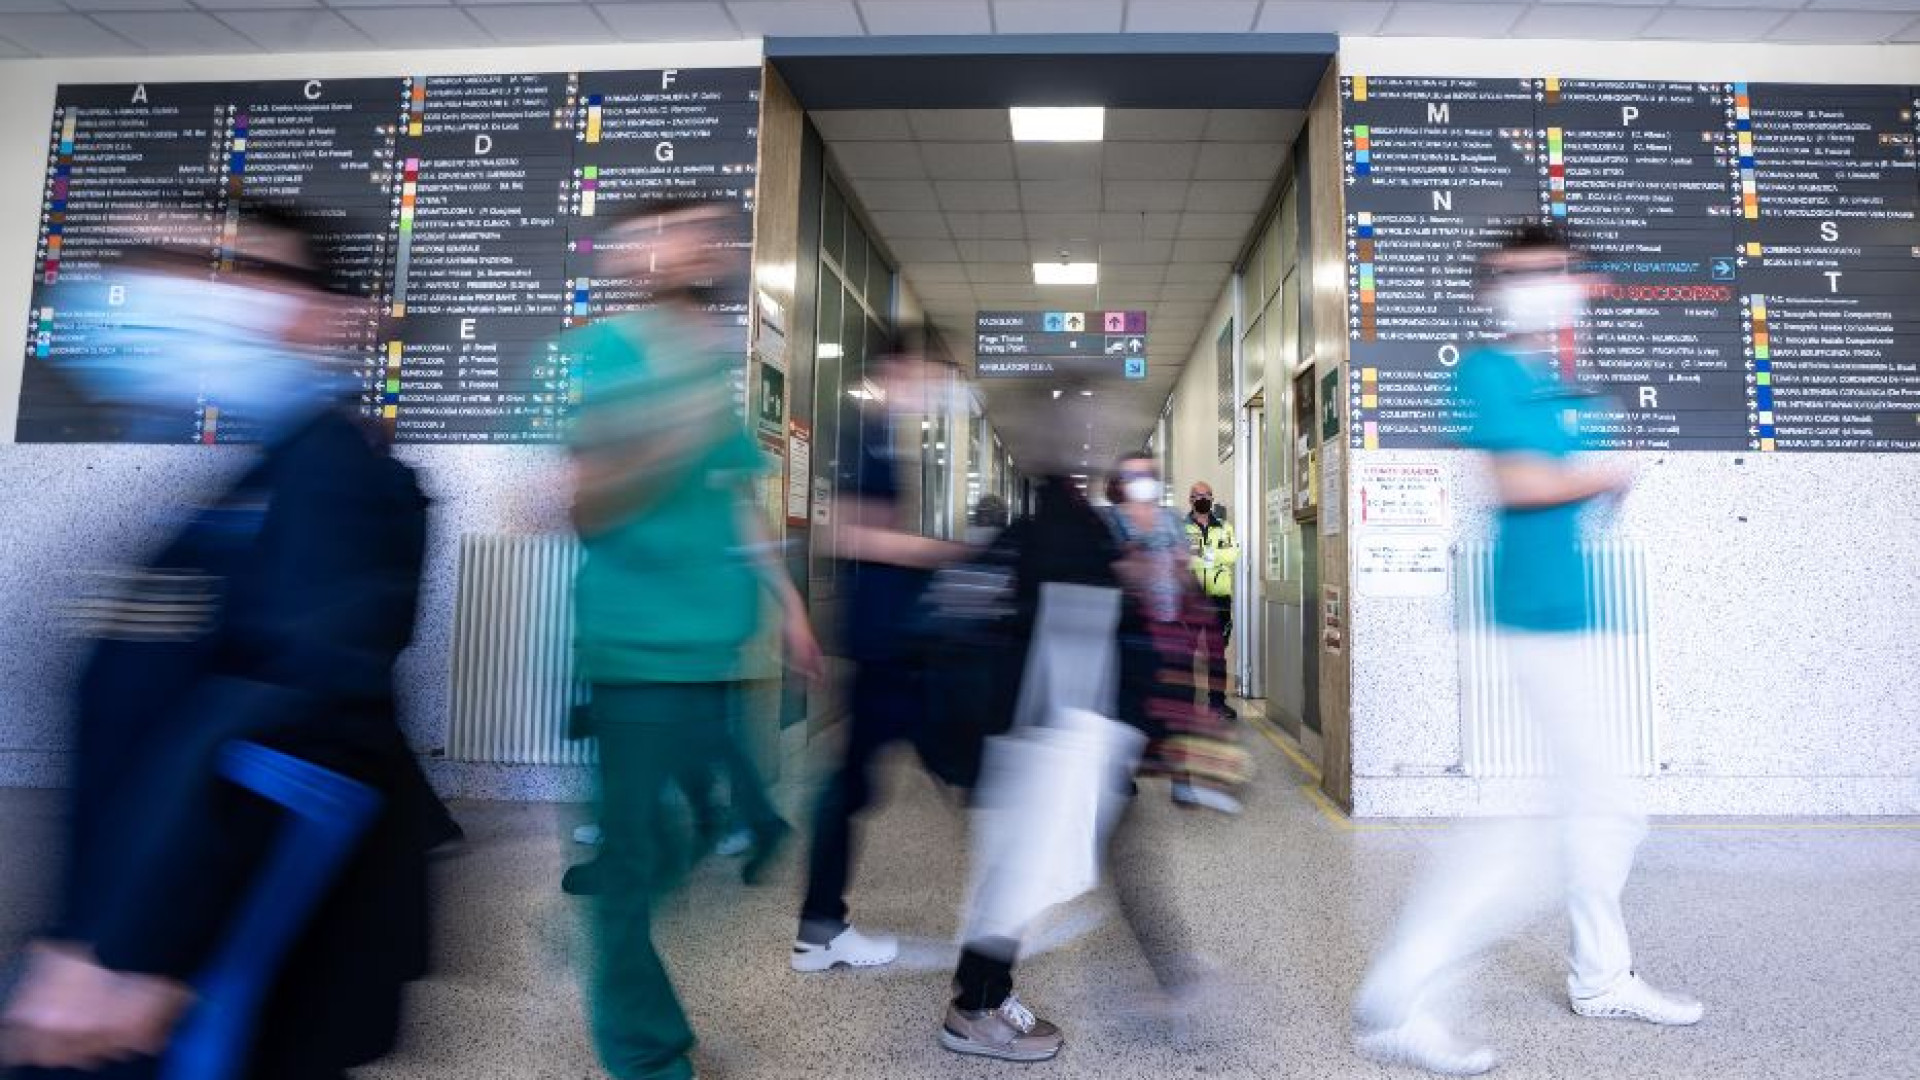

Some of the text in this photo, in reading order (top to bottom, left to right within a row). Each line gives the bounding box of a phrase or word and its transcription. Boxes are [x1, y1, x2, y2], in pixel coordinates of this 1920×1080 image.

[304, 80, 322, 99] C
[662, 70, 677, 89] F
[131, 83, 148, 103] A
[1427, 102, 1450, 124] M
[1622, 106, 1639, 126] P
[475, 135, 492, 155] D
[655, 141, 674, 162] G
[1432, 190, 1452, 211] N
[1820, 221, 1839, 242] S
[1823, 271, 1843, 292] T
[109, 285, 125, 305] B
[460, 318, 476, 340] E
[1438, 345, 1459, 366] O
[1639, 386, 1658, 408] R
